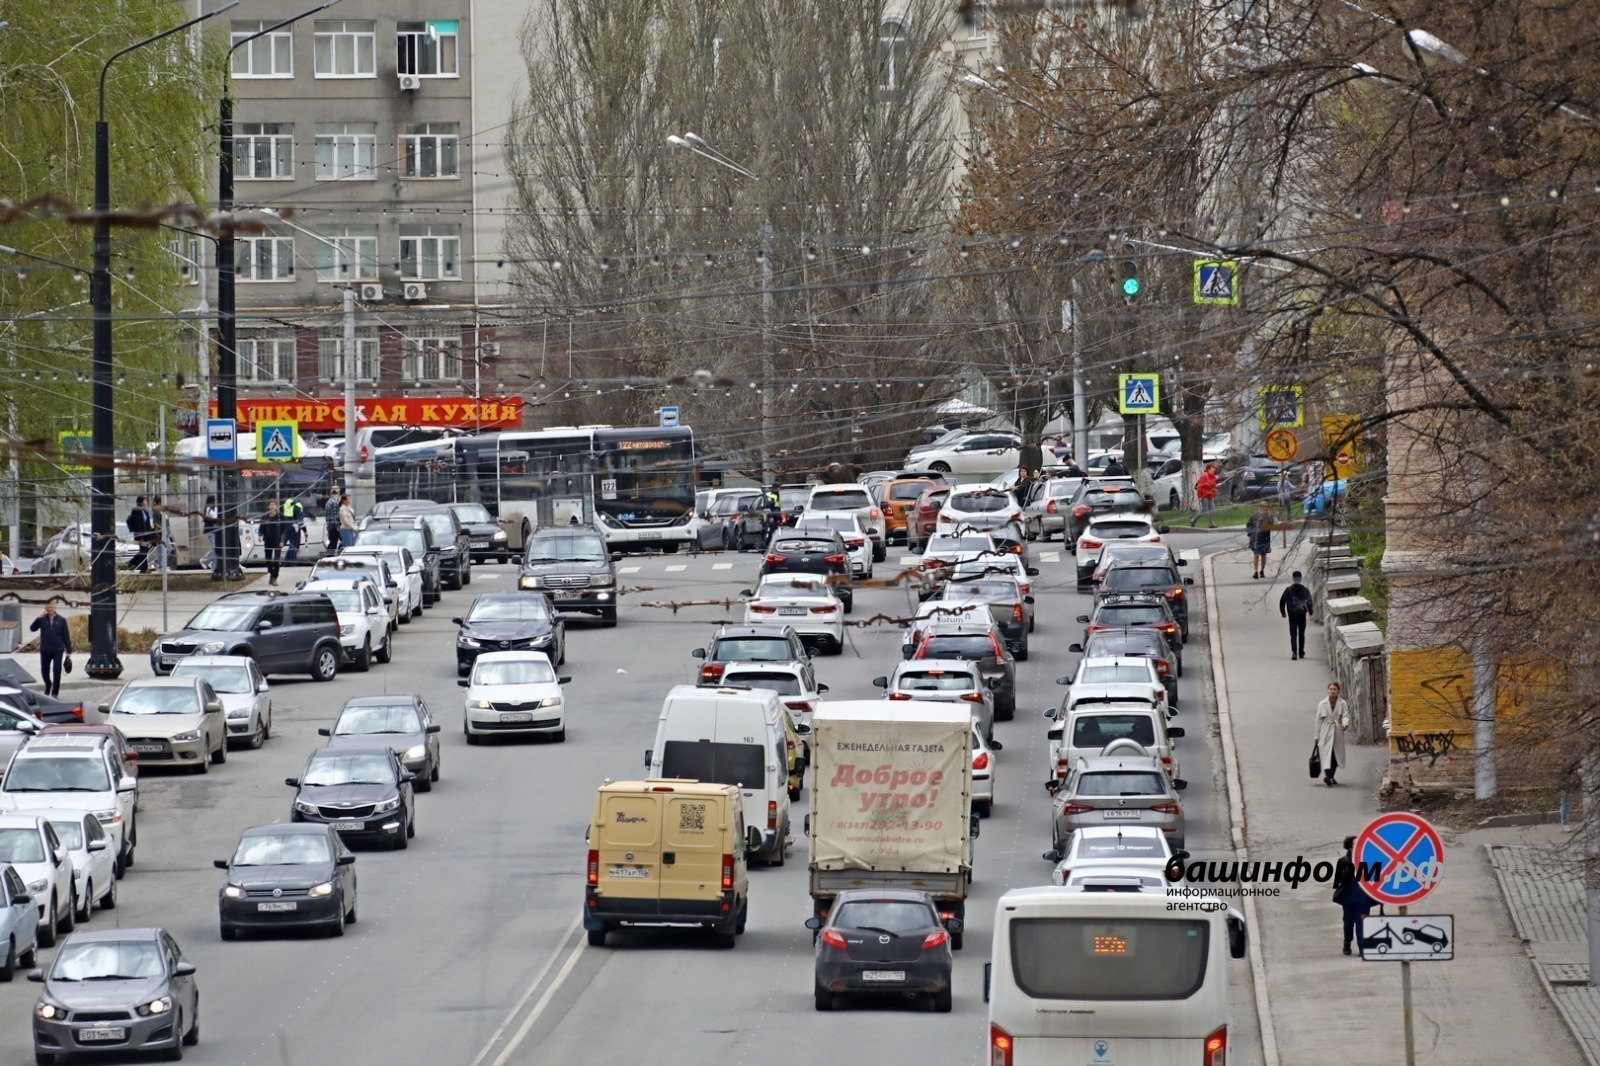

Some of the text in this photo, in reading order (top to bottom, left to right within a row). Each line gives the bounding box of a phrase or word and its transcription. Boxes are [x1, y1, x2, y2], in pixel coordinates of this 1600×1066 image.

[421, 404, 517, 422] КУХНЯ
[603, 482, 615, 491] 122
[837, 742, 945, 753] ЕЖЕНЕДЕЛЬНАЯ ГАЗЕТА
[830, 764, 944, 791] Доброе
[858, 789, 939, 813] утро!
